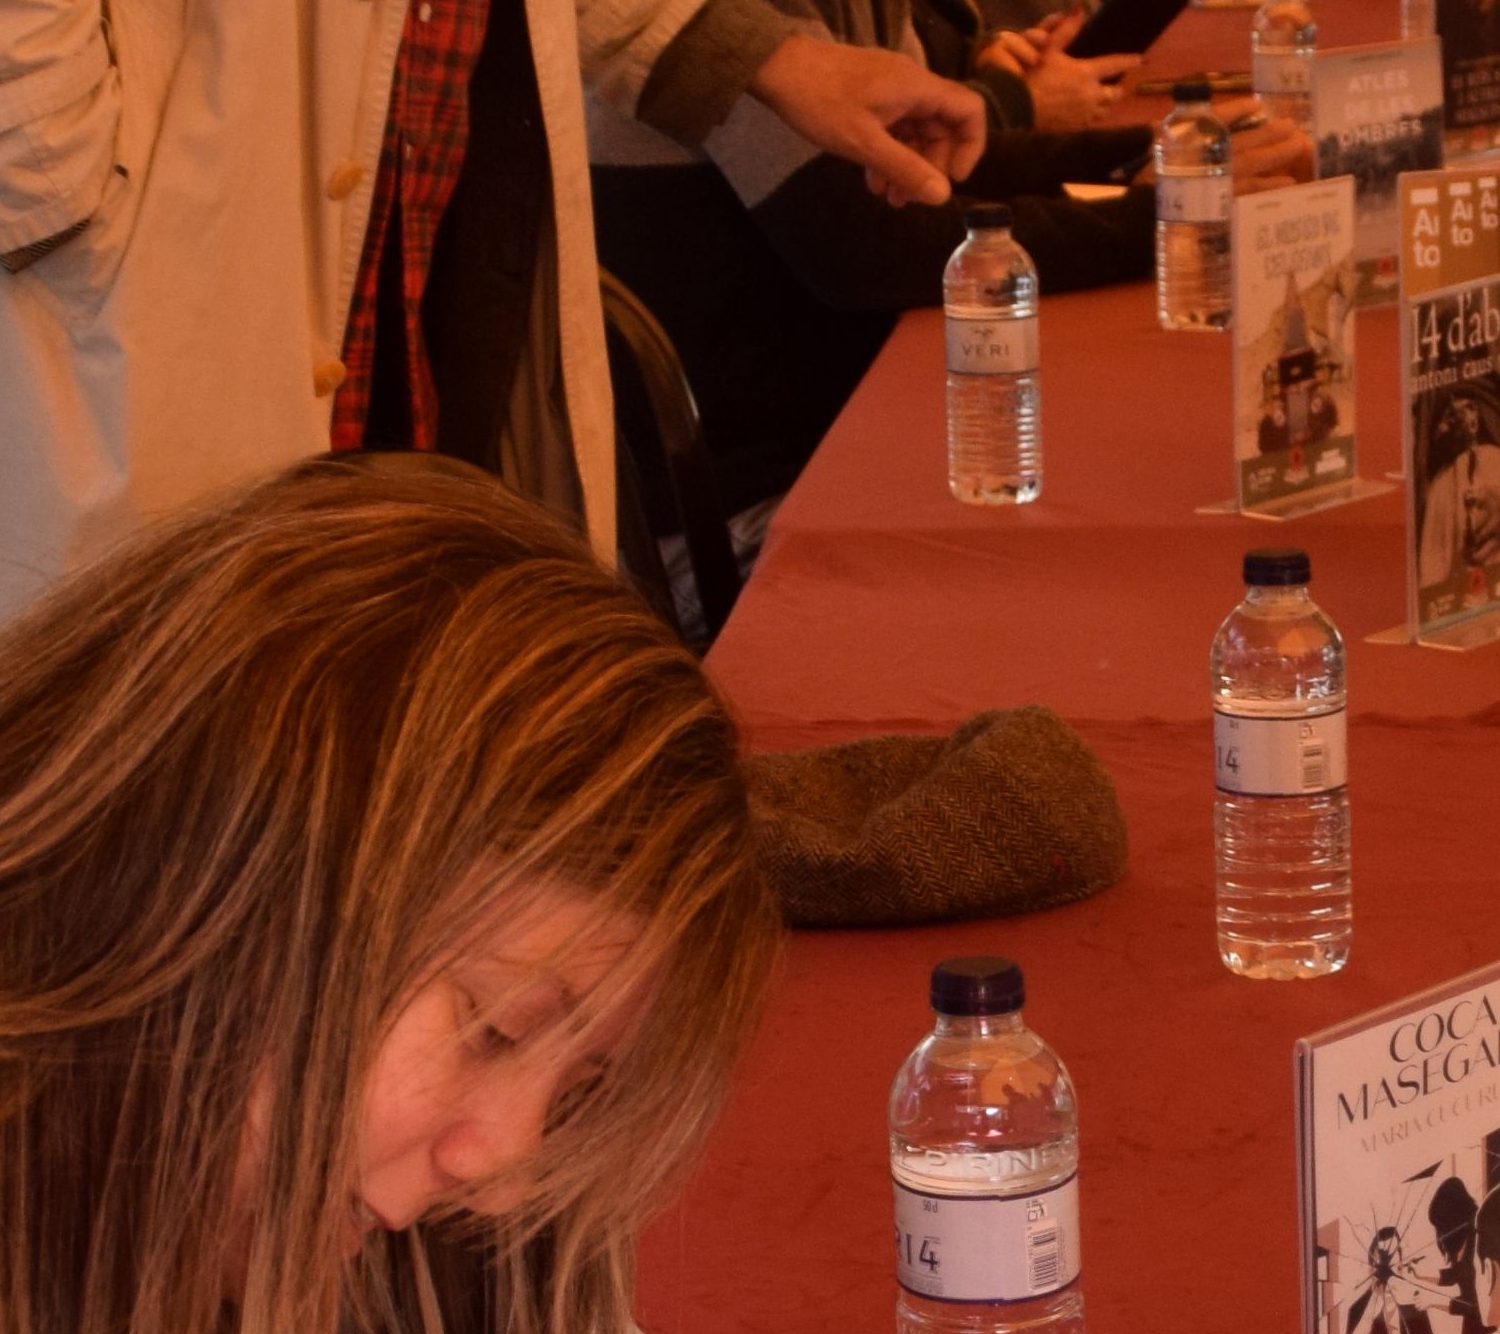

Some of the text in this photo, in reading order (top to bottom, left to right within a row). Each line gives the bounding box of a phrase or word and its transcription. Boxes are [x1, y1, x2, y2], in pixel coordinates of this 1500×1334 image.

[1414, 240, 1441, 268] to
[961, 343, 1010, 357] VERI
[1411, 302, 1442, 364] 14
[1388, 994, 1498, 1063] COCA
